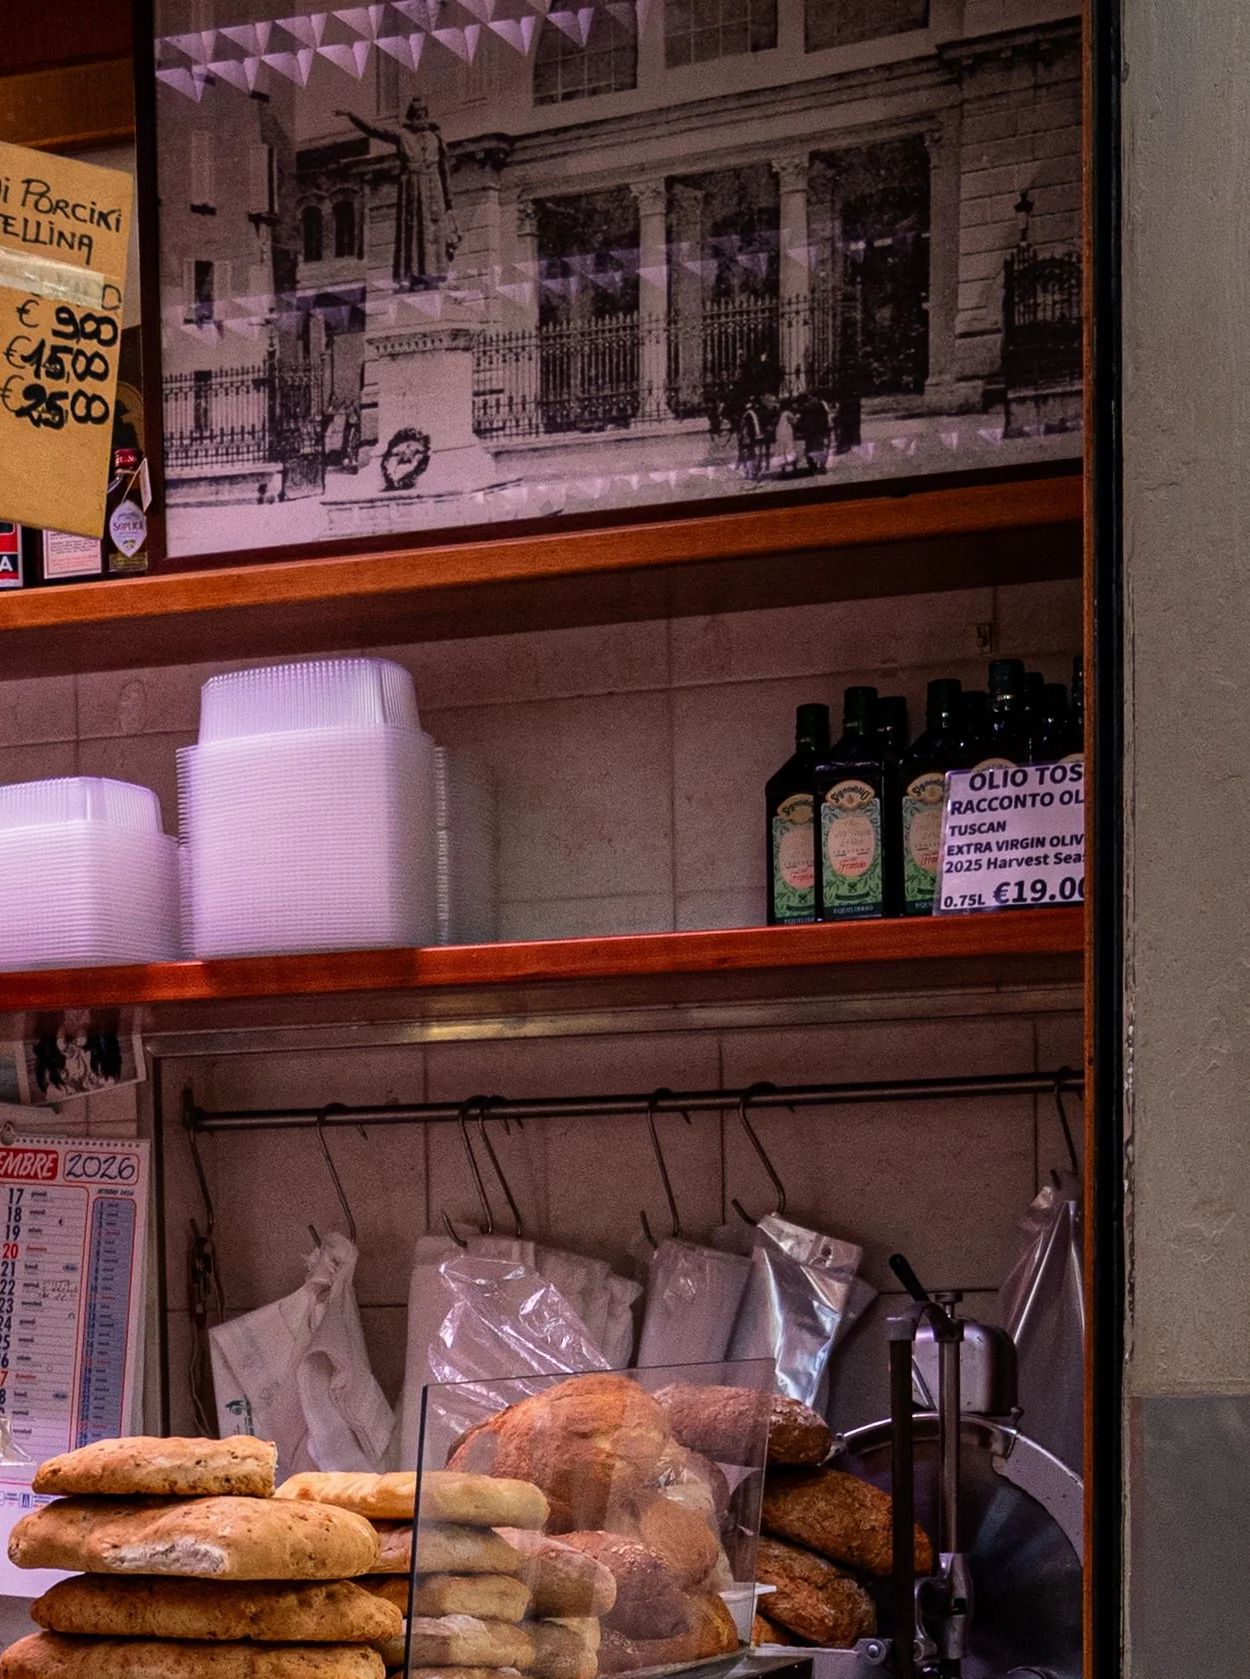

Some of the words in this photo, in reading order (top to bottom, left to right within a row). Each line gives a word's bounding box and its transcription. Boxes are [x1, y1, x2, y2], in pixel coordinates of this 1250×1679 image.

[968, 768, 1029, 793] OLIO
[1034, 763, 1084, 786] TOS
[950, 790, 1054, 815] RACCONTO
[948, 820, 1007, 837] TUSCAN
[946, 840, 993, 857] EXTRA
[996, 836, 1045, 854] VIRGIN
[944, 859, 983, 874] 2025
[986, 854, 1050, 870] Harvest
[943, 893, 986, 908] 0.75L
[65, 1153, 136, 1181] 2026
[8, 1187, 24, 1205] 17
[6, 1206, 22, 1223] 18
[5, 1224, 21, 1241] 19
[2, 1242, 19, 1259] 20
[0, 1261, 16, 1278] 21
[0, 1280, 16, 1296] 22
